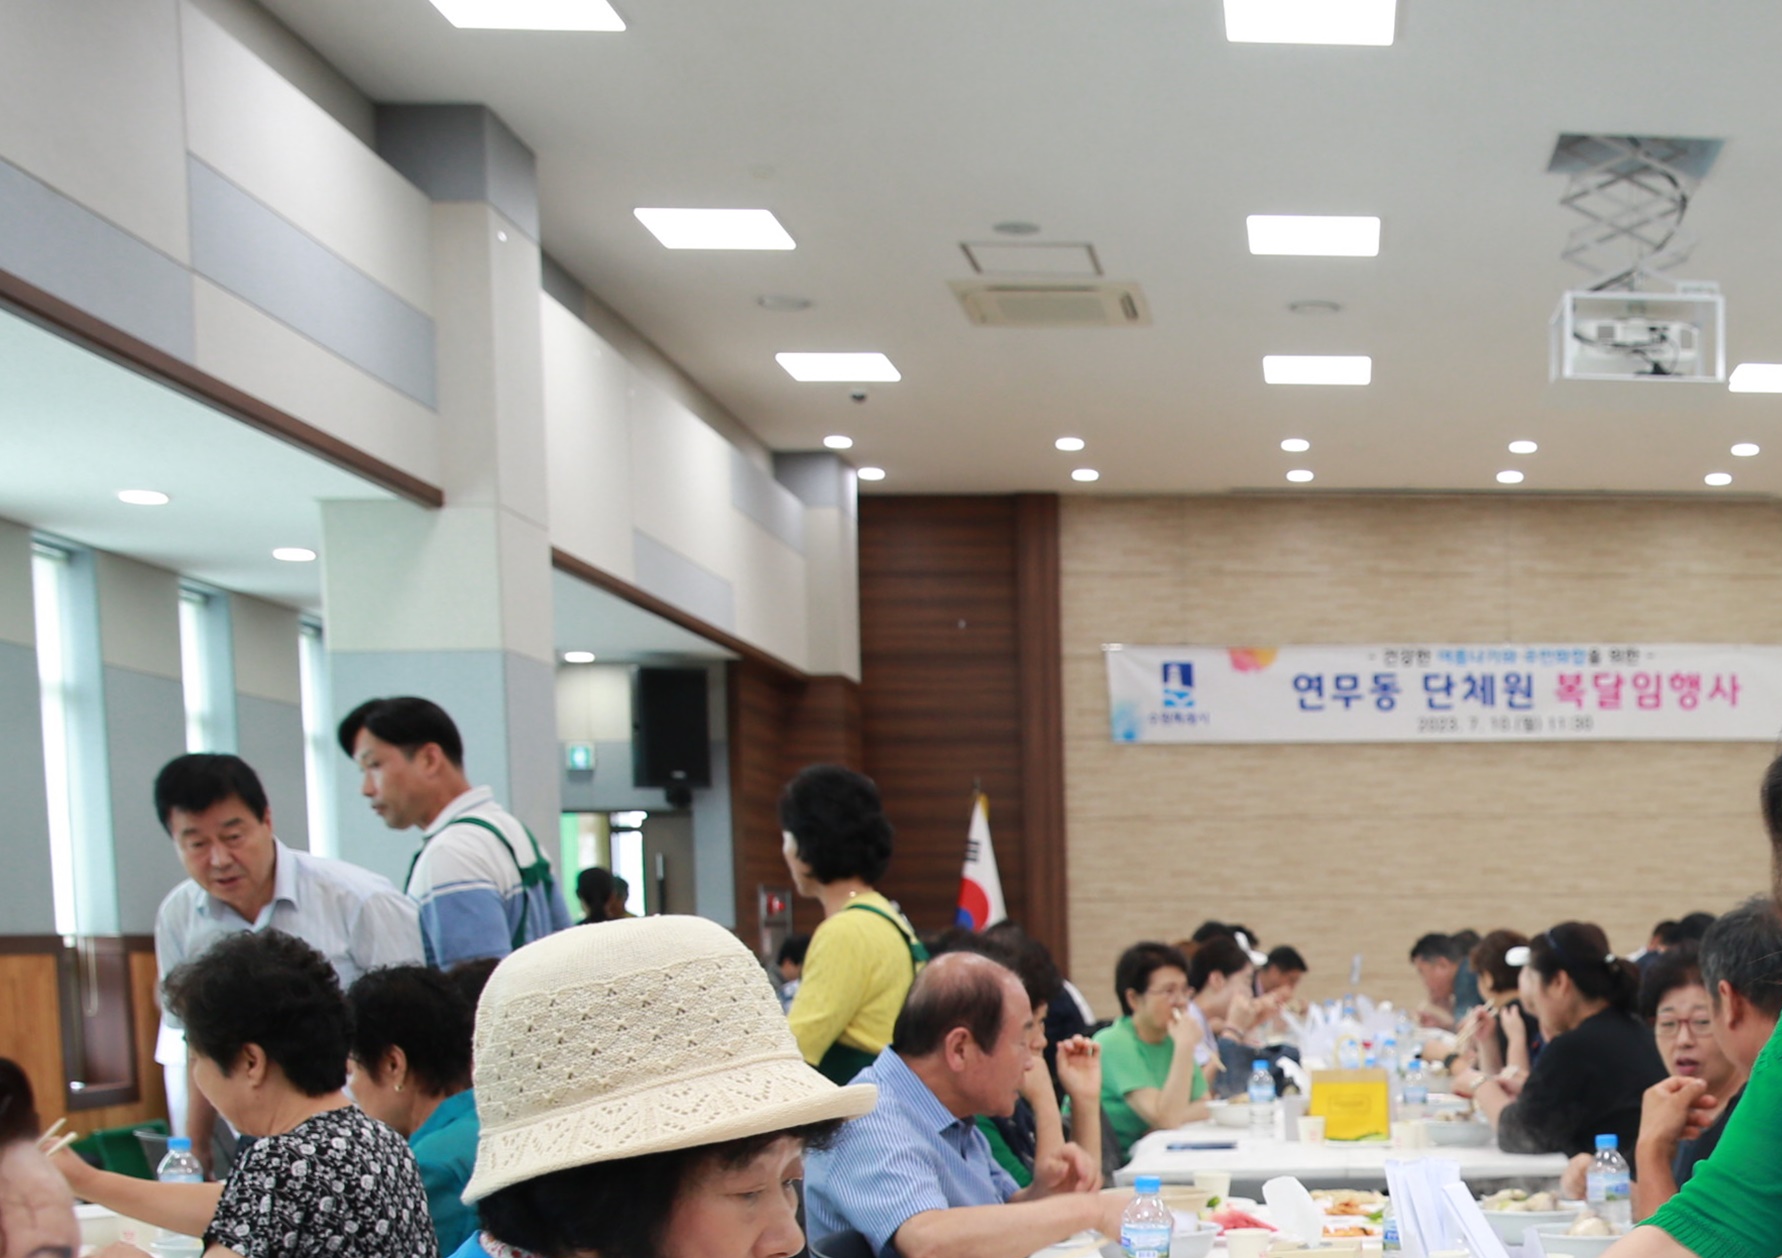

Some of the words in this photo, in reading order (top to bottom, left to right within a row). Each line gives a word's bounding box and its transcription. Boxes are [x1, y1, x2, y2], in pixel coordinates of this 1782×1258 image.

[1292, 672, 1402, 713] 연무동
[1423, 672, 1535, 711] 단체원
[1555, 672, 1743, 710] 복달임행사
